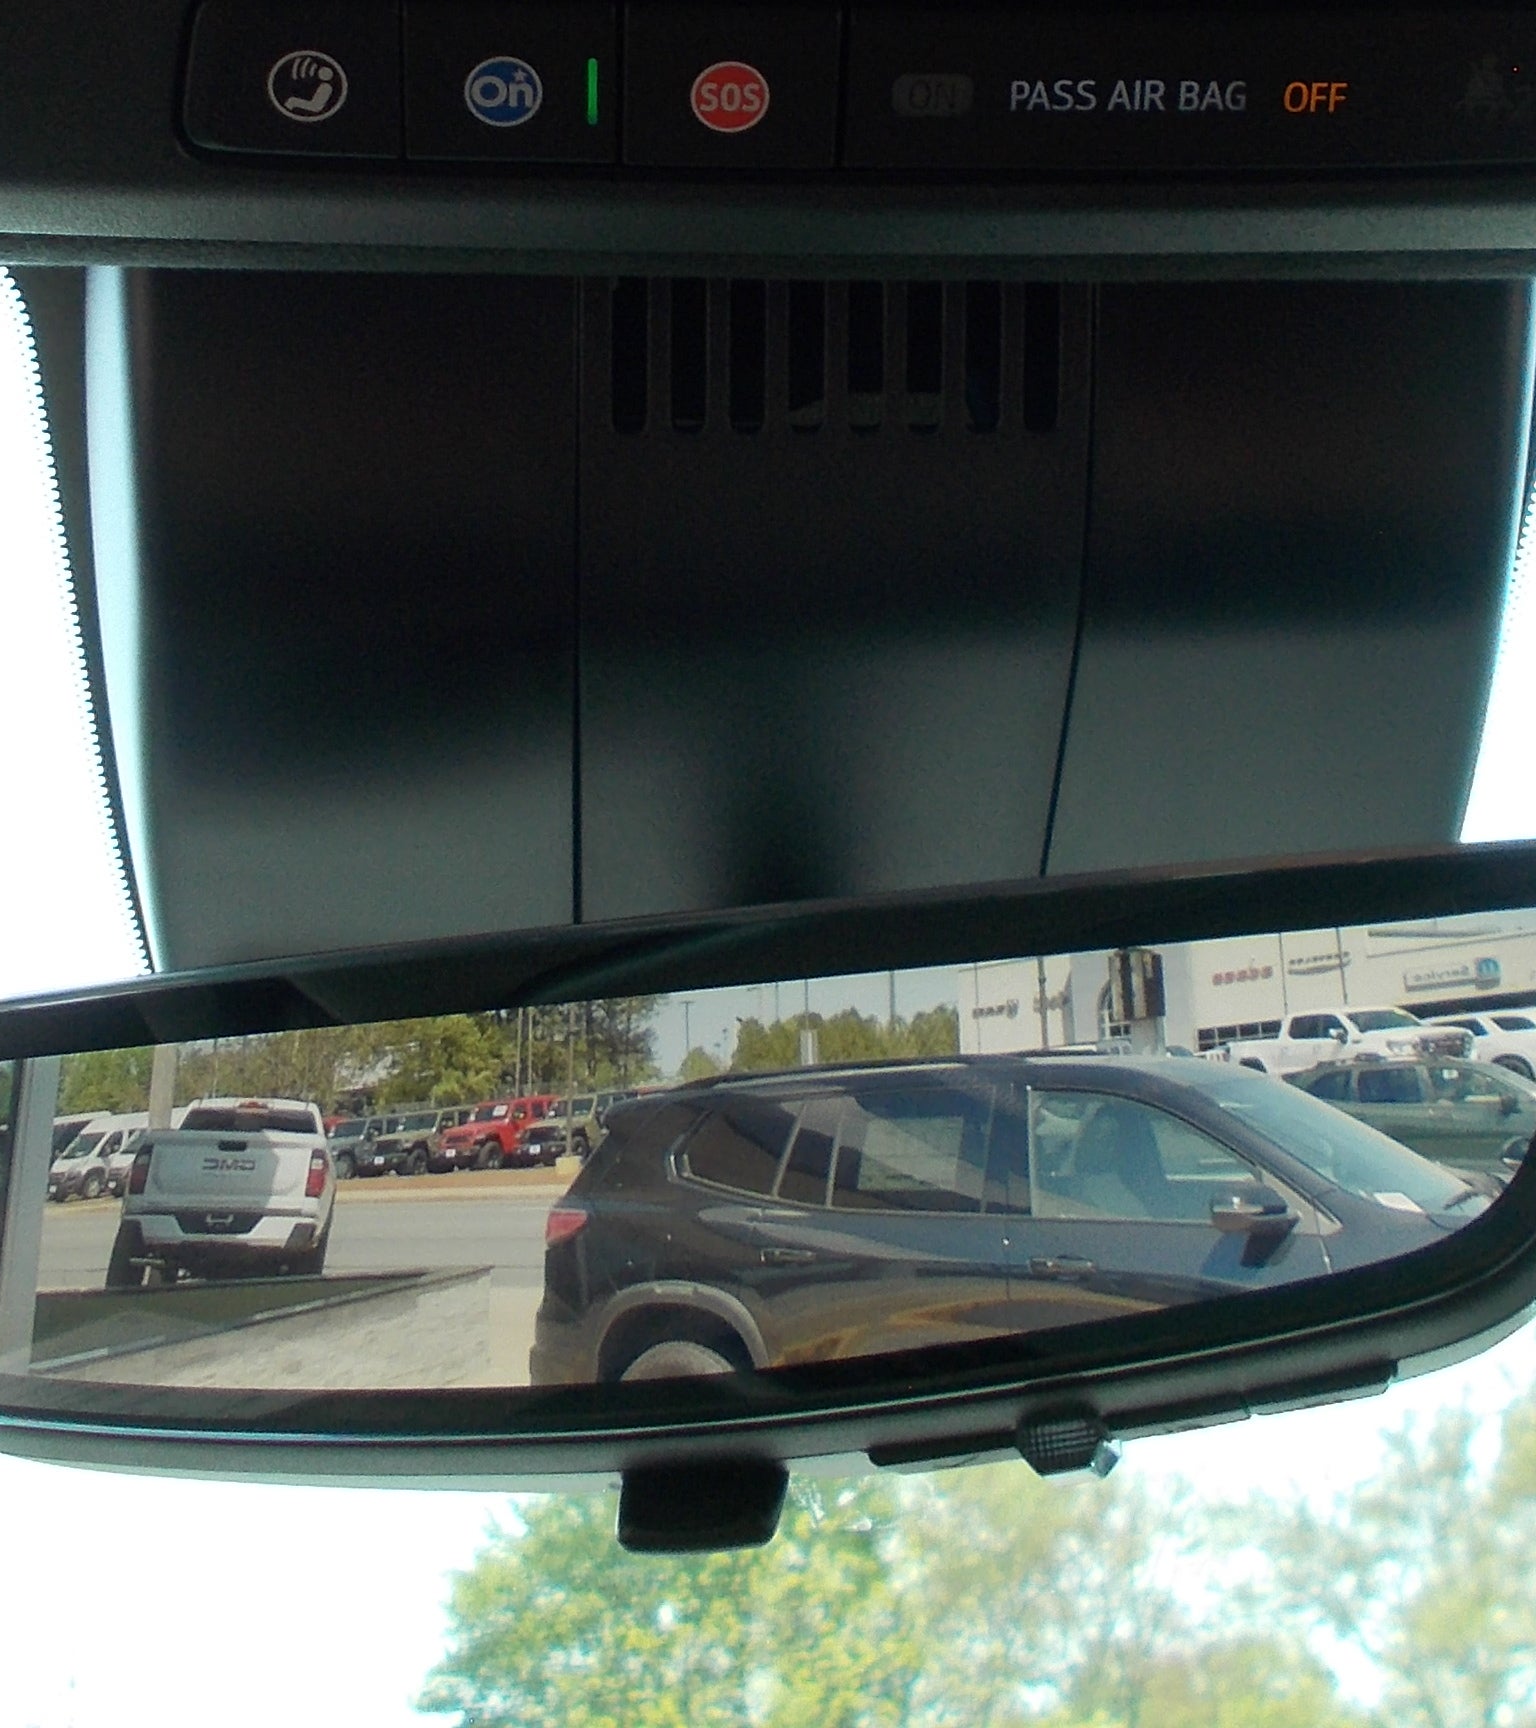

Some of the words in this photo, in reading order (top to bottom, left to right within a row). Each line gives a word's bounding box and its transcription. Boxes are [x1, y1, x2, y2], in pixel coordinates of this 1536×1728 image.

[698, 81, 762, 113] SOS
[1008, 78, 1098, 113] PASS
[1105, 79, 1167, 113] AIR
[1176, 79, 1249, 114] BAG
[1281, 80, 1350, 115] OFF
